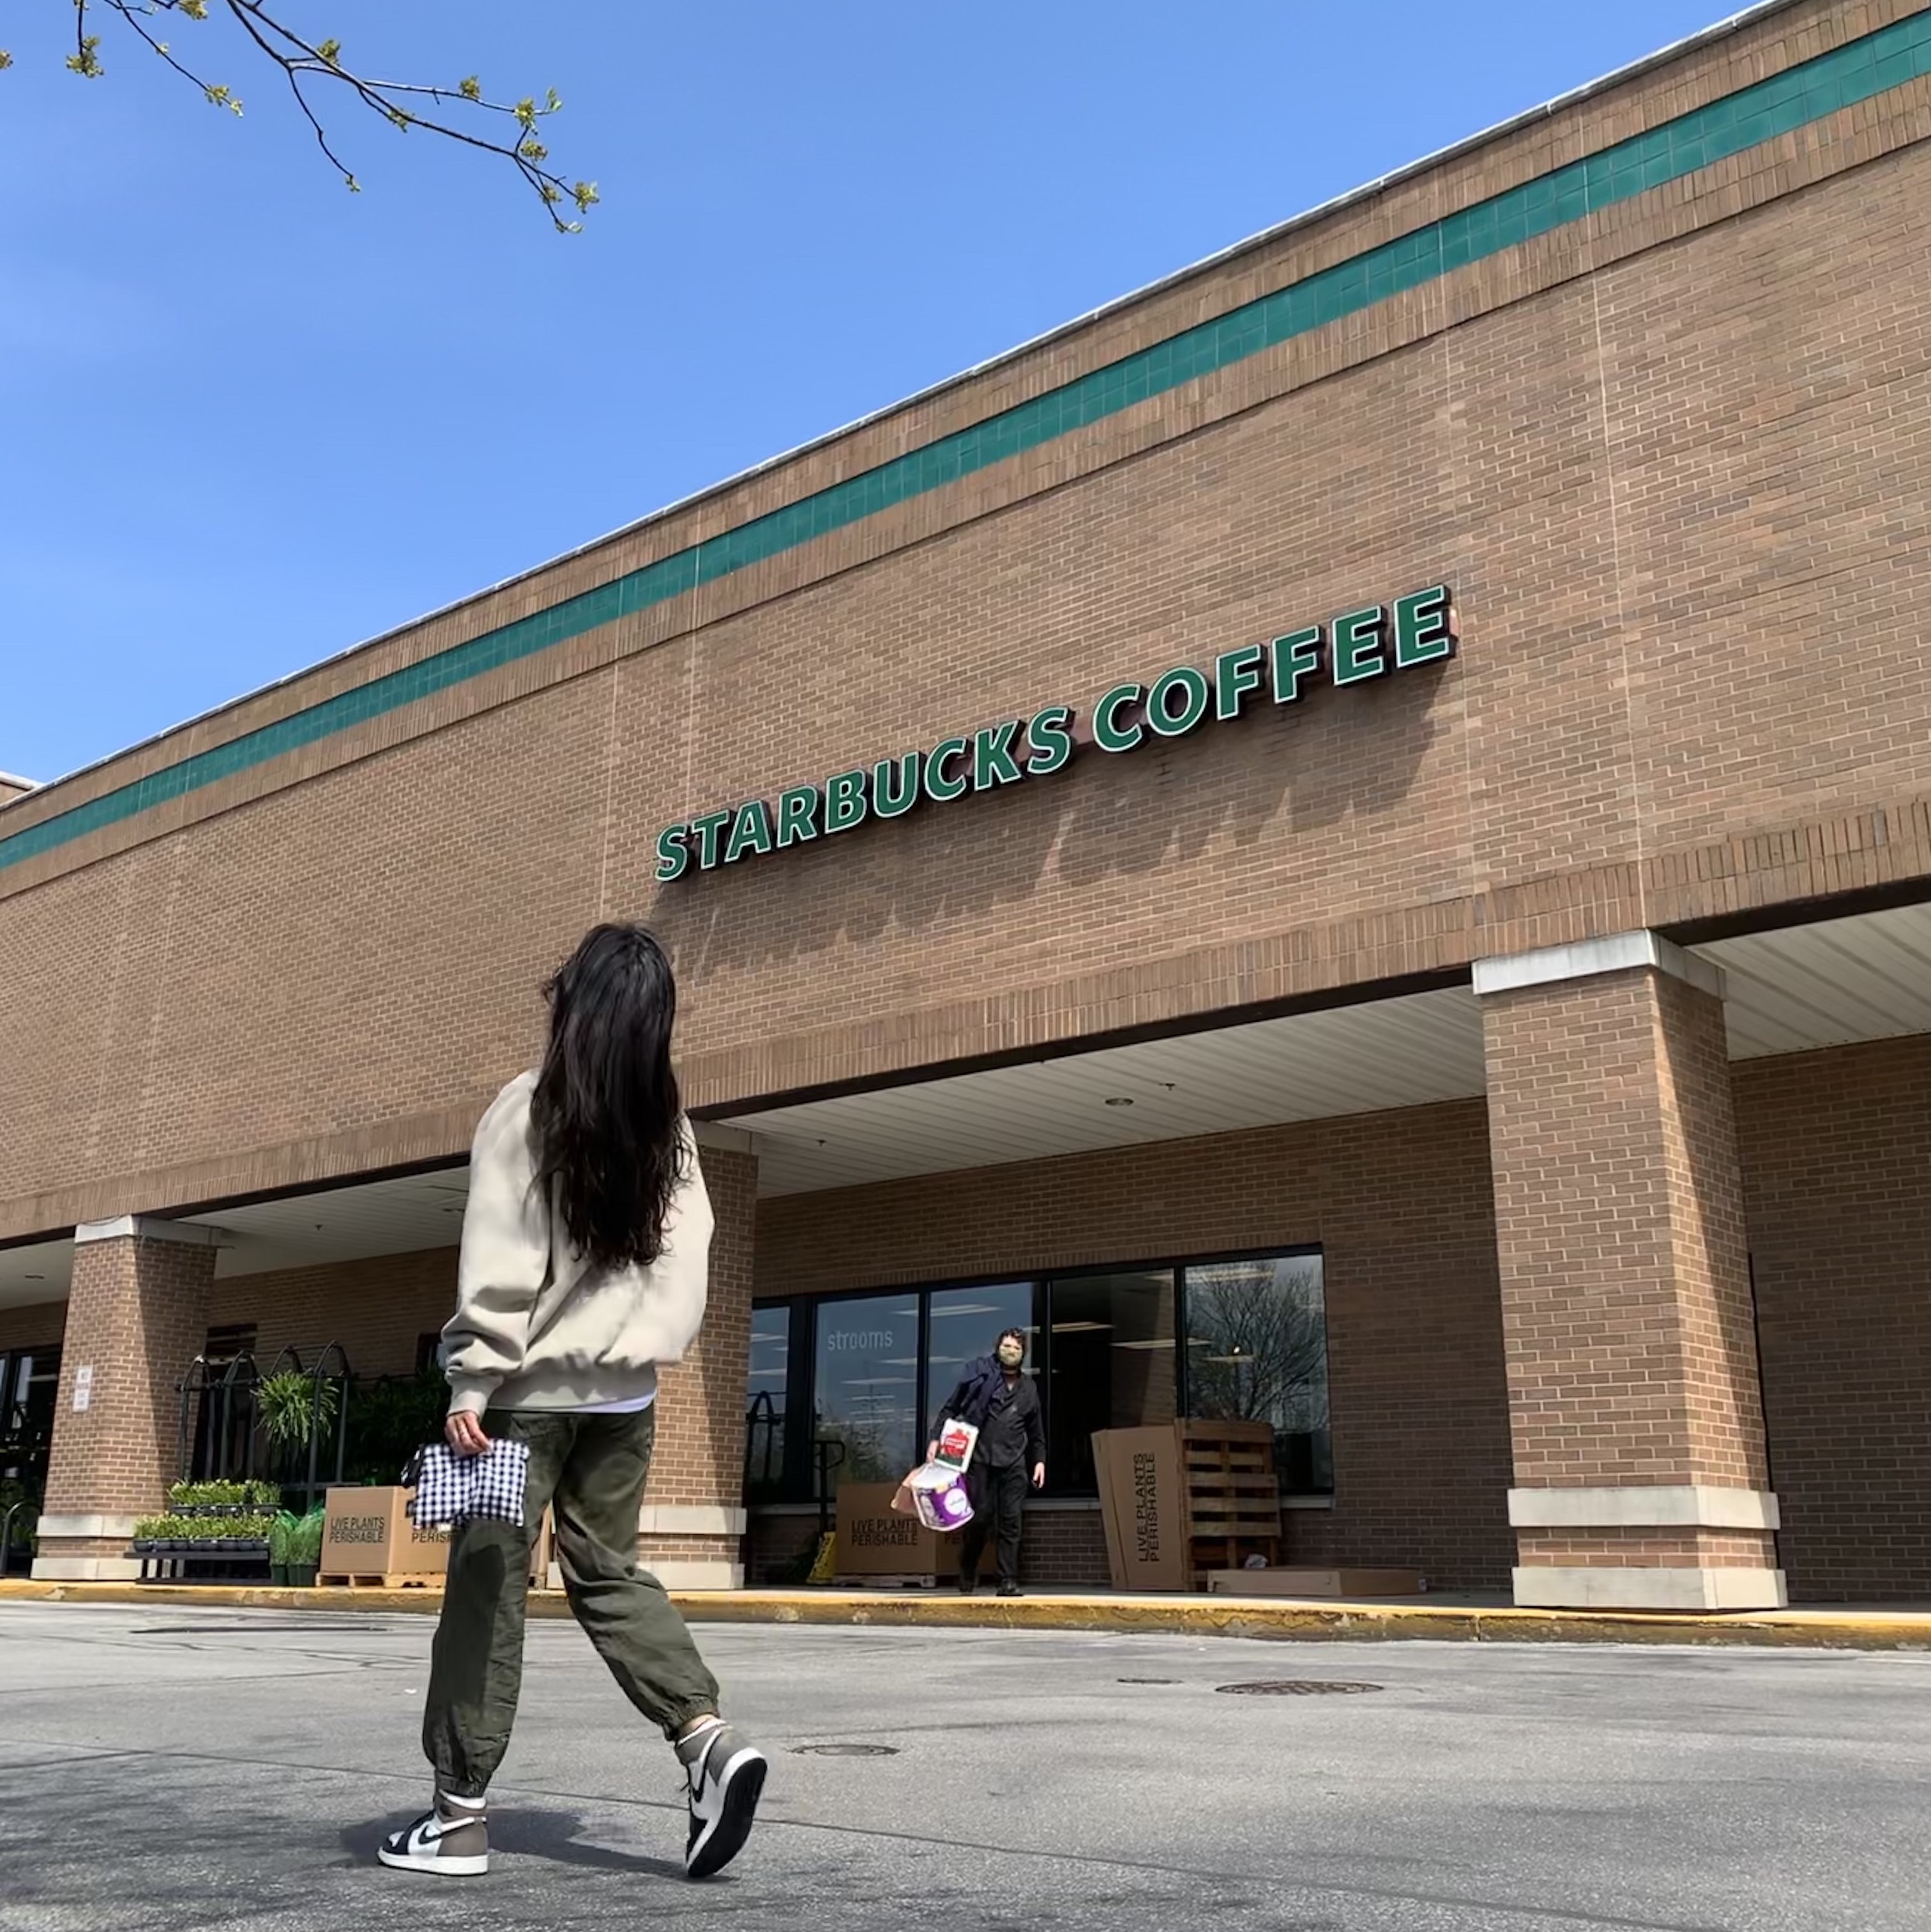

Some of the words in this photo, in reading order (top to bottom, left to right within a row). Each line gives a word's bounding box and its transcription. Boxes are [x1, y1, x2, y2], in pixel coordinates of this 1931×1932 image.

[655, 705, 1073, 881] STARBUCKS
[1093, 584, 1451, 753] COFFEE
[1133, 1453, 1146, 1519] PLANTS
[1145, 1452, 1160, 1562] PERISHABLE
[330, 1517, 351, 1529] LIVE
[352, 1516, 385, 1530] PLANTS
[851, 1519, 874, 1532] LIVE
[329, 1532, 384, 1543] PERISHABLE
[851, 1533, 918, 1546] PERISHABLE
[1137, 1526, 1149, 1562] LIVE
